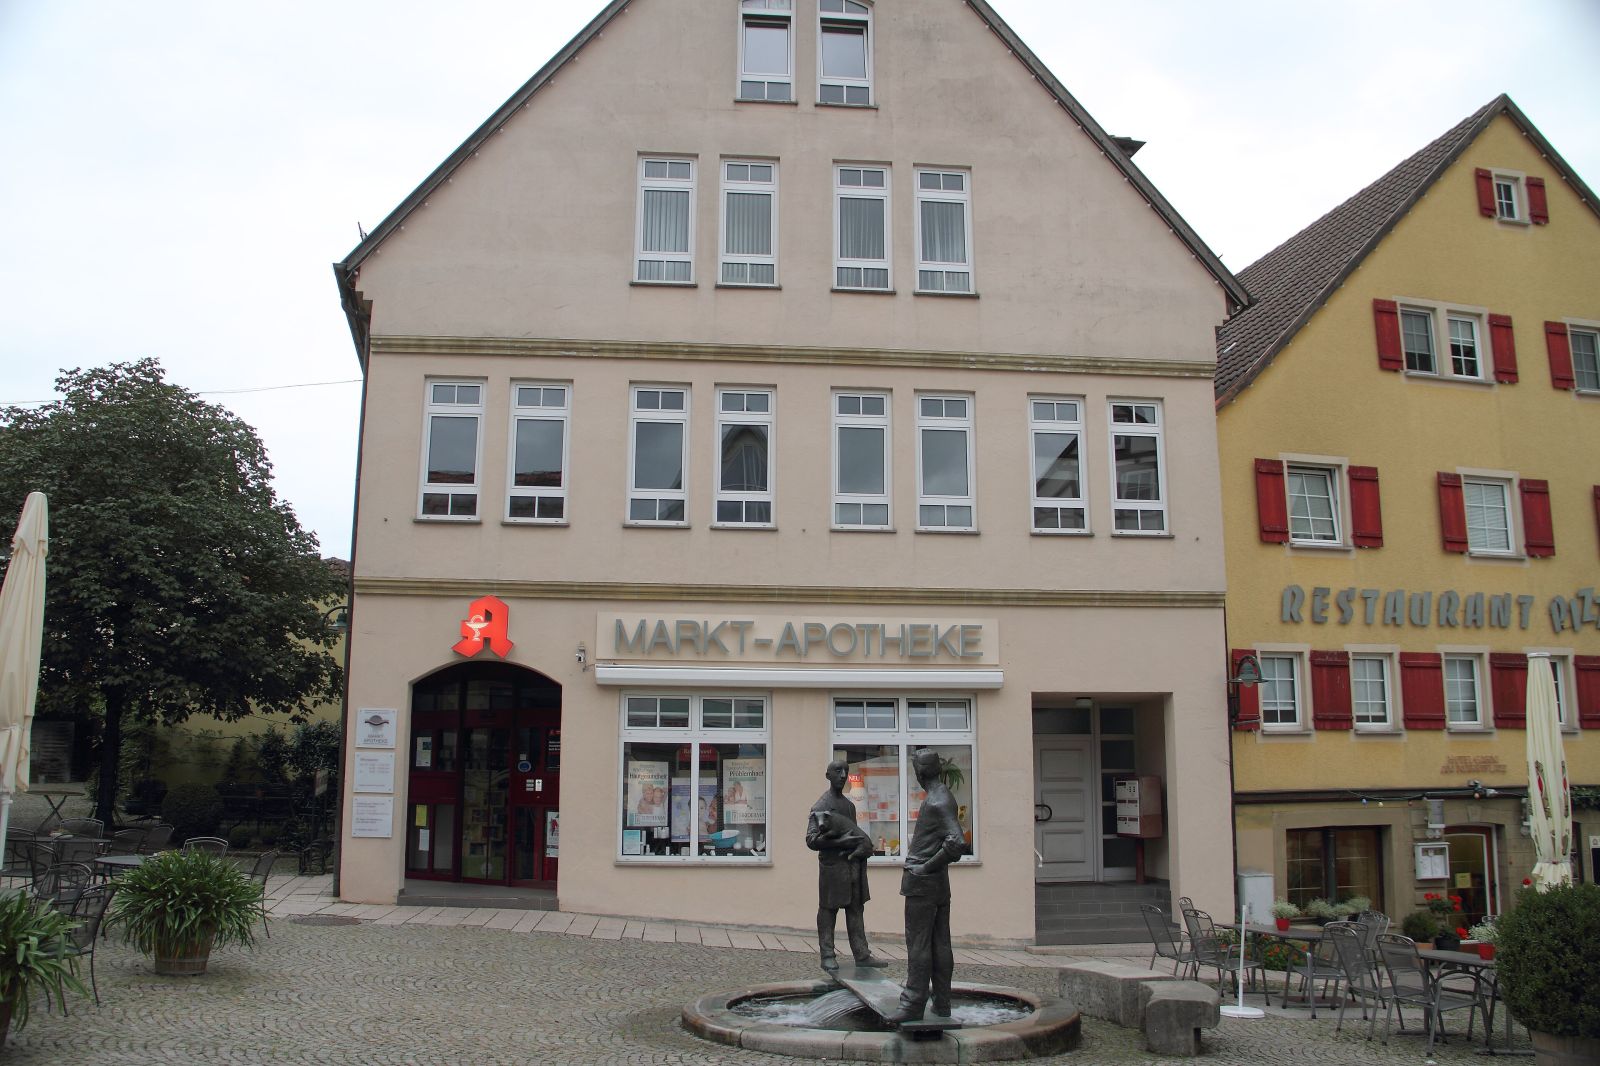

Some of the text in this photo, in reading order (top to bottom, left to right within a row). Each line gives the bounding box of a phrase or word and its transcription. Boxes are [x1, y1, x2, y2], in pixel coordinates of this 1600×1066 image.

[1280, 584, 1600, 632] RESTAURANT PIZ
[614, 618, 984, 658] MARKT-APOTHEKE
